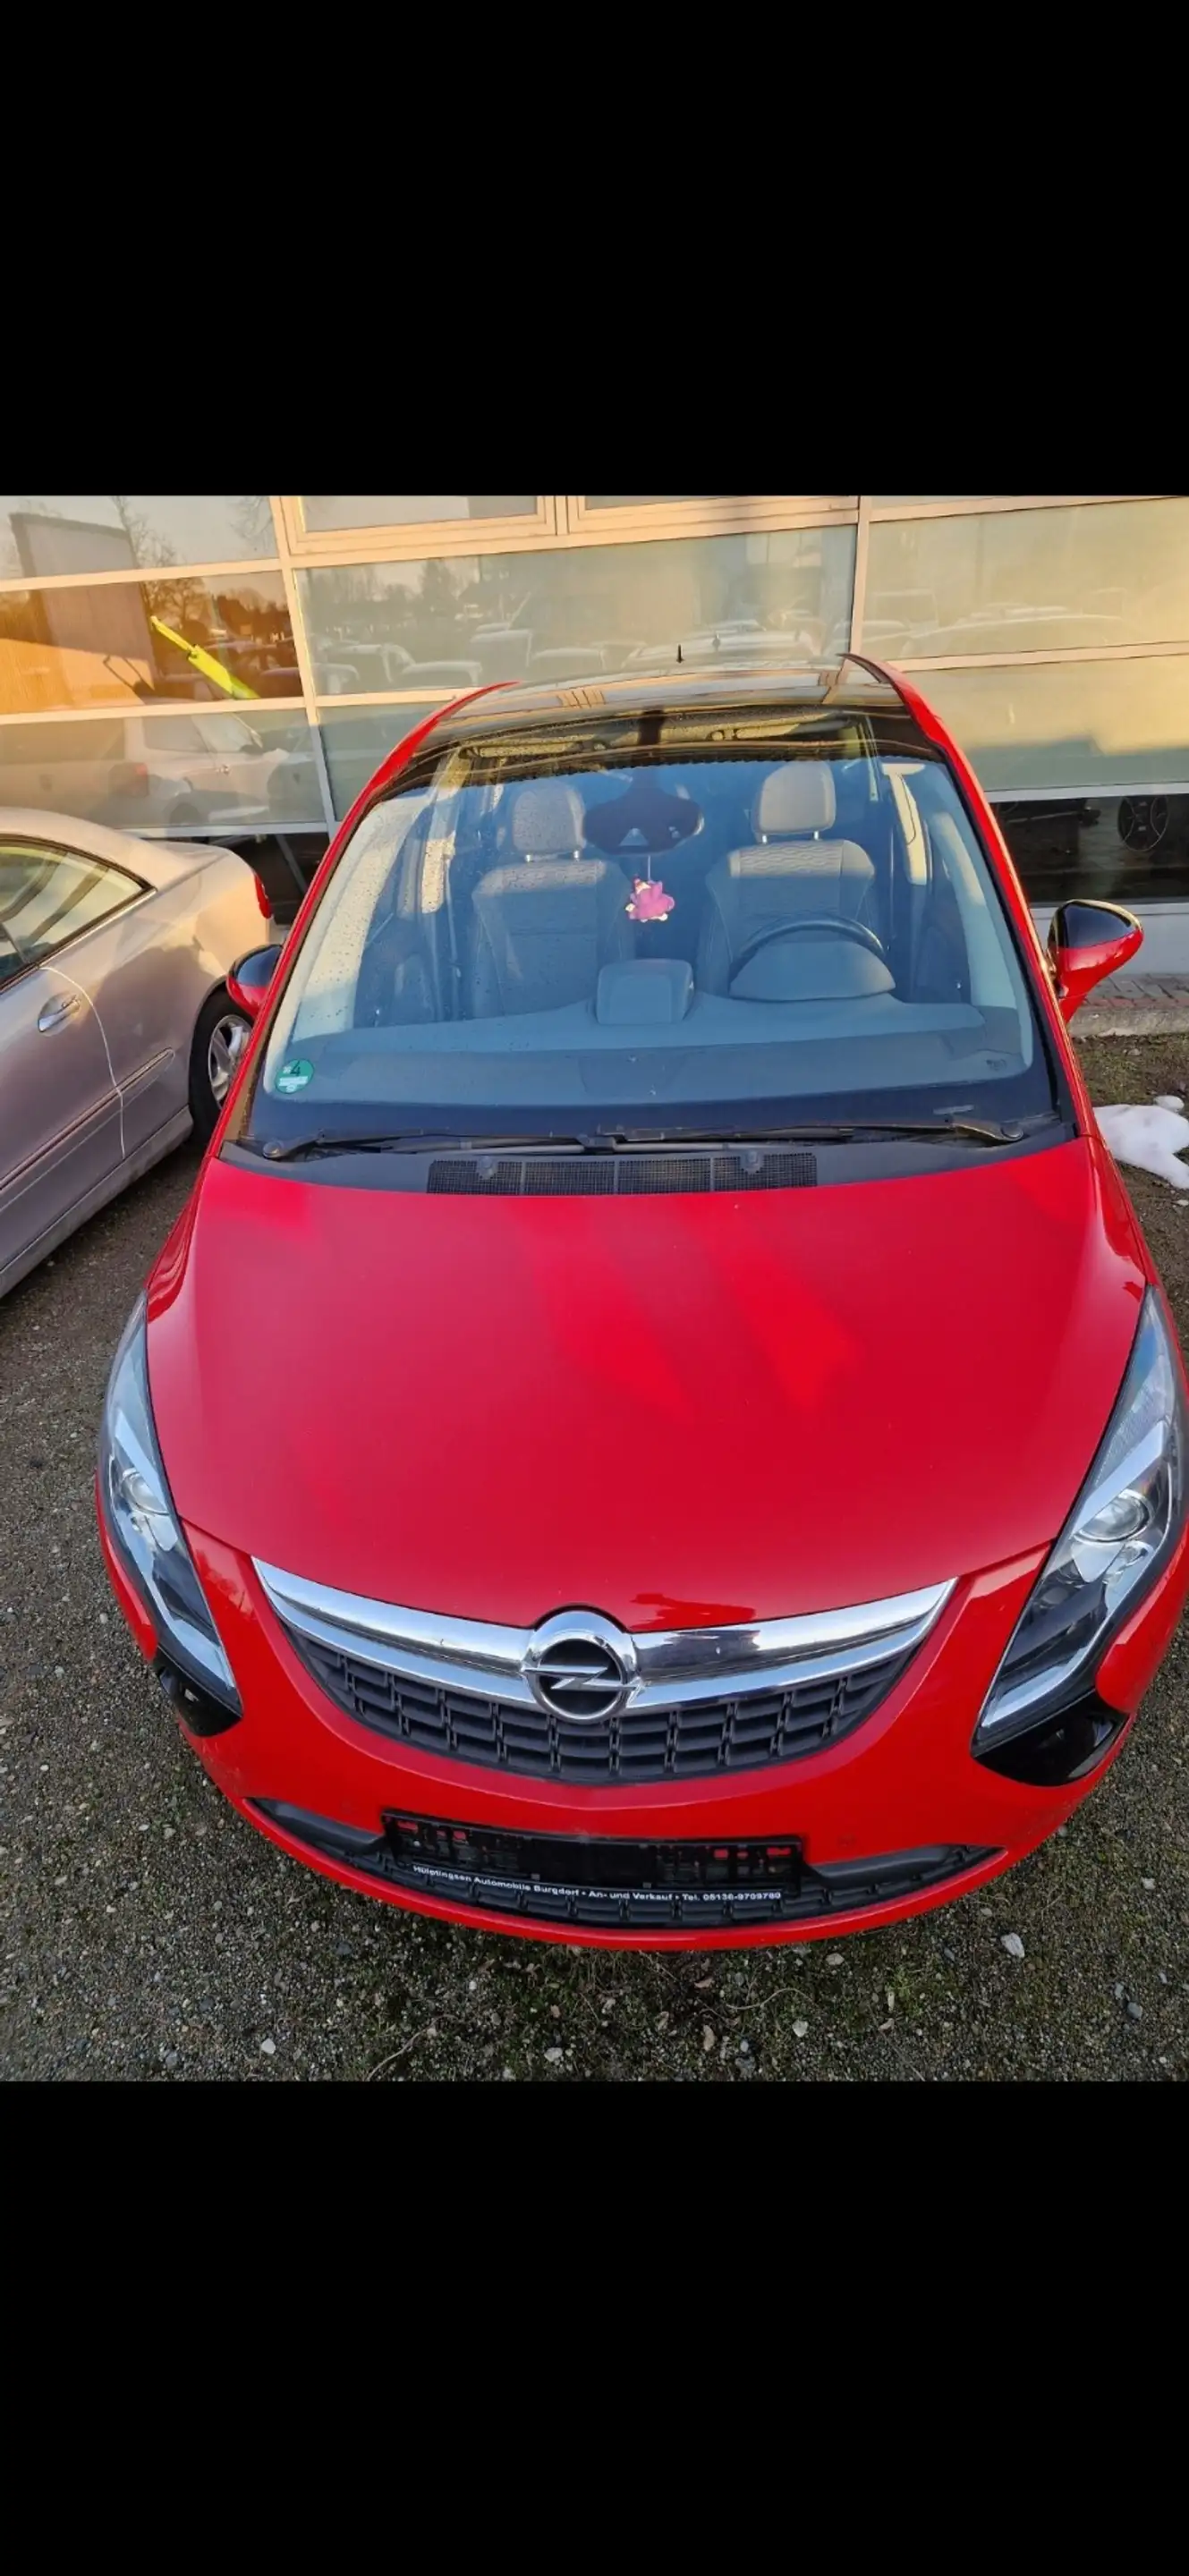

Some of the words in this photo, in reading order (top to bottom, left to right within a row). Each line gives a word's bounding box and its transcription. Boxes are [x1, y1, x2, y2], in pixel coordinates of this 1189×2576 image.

[290, 1060, 301, 1077] 4
[474, 1877, 531, 1890] Automobile
[534, 1885, 580, 1895] Burgdorf
[609, 1891, 630, 1899] und
